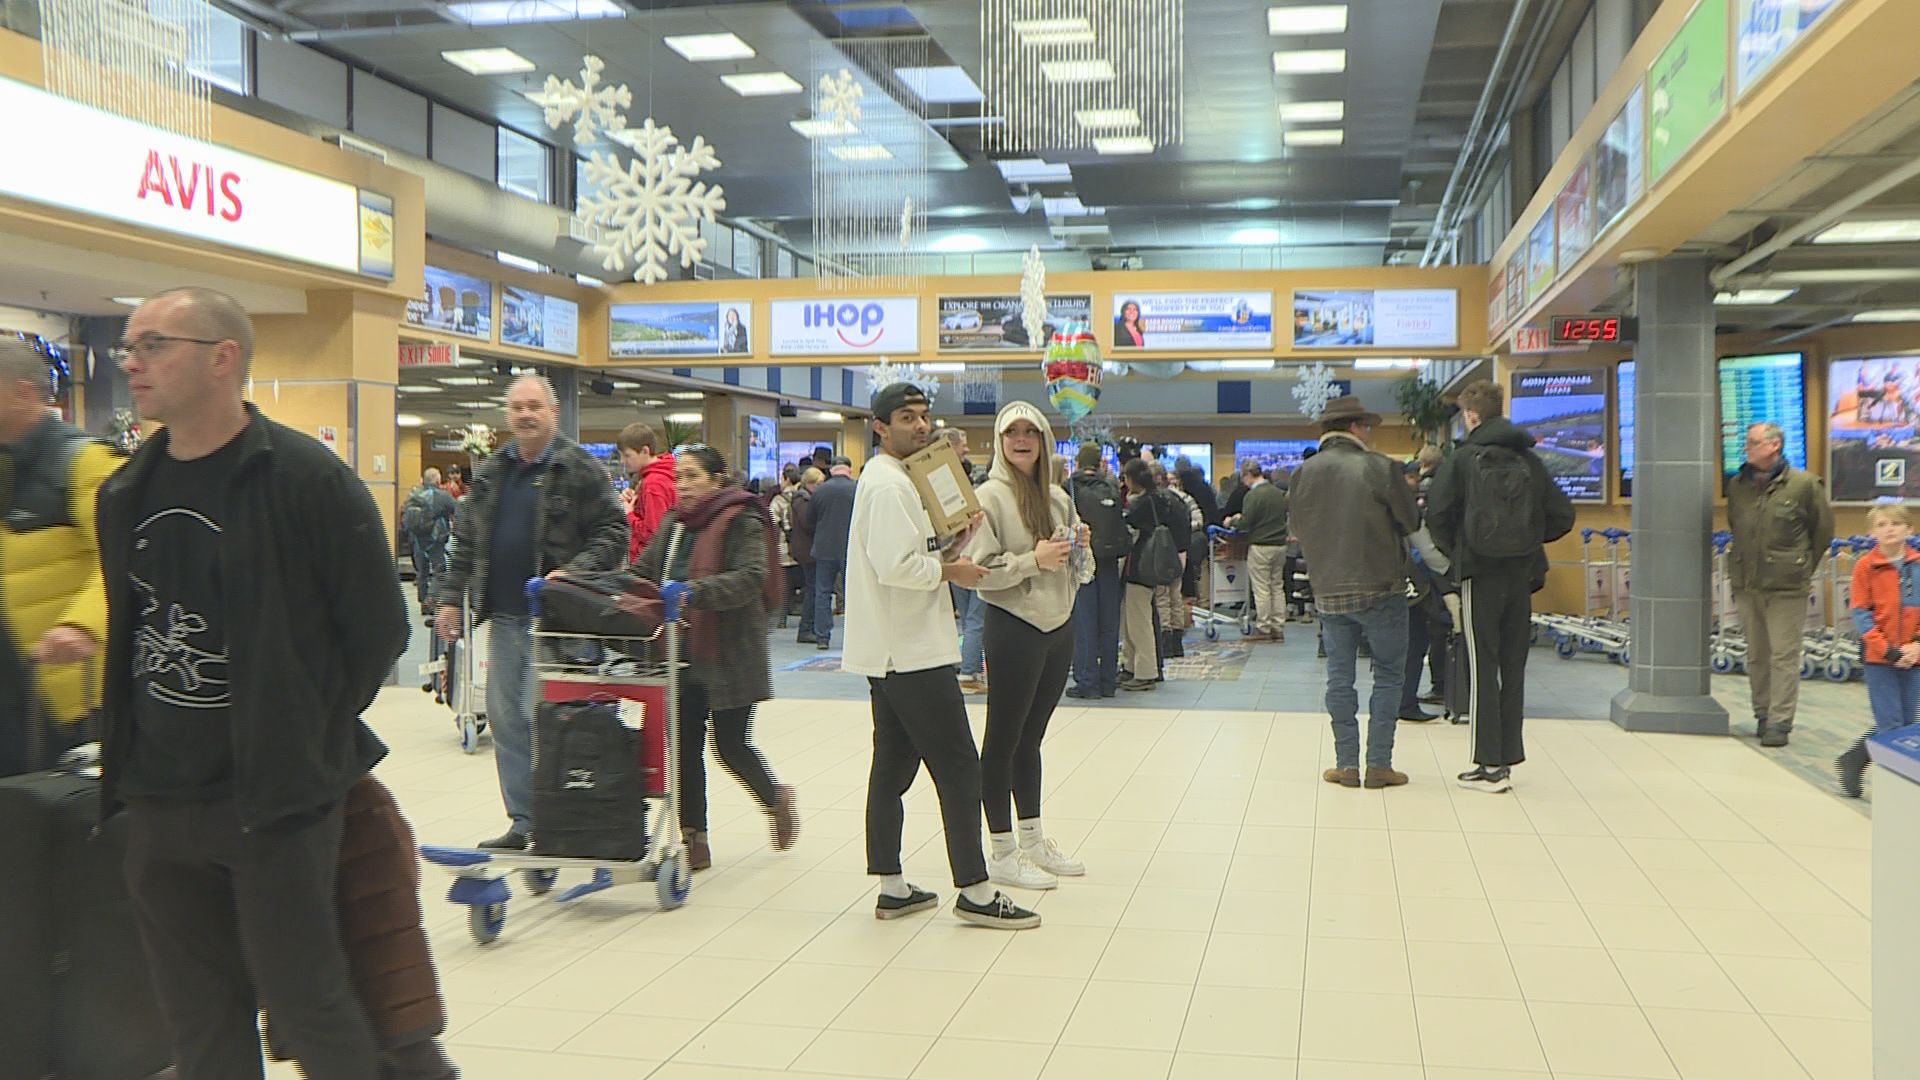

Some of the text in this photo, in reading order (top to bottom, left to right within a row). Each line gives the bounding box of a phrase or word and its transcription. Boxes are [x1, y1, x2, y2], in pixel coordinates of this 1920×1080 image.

[137, 149, 243, 222] AVIS
[944, 301, 978, 310] EXPLORE
[1054, 299, 1086, 308] LUXURY
[804, 302, 884, 335] IHOP
[1516, 328, 1549, 352] EXIT
[1546, 375, 1592, 385] PARALLEL
